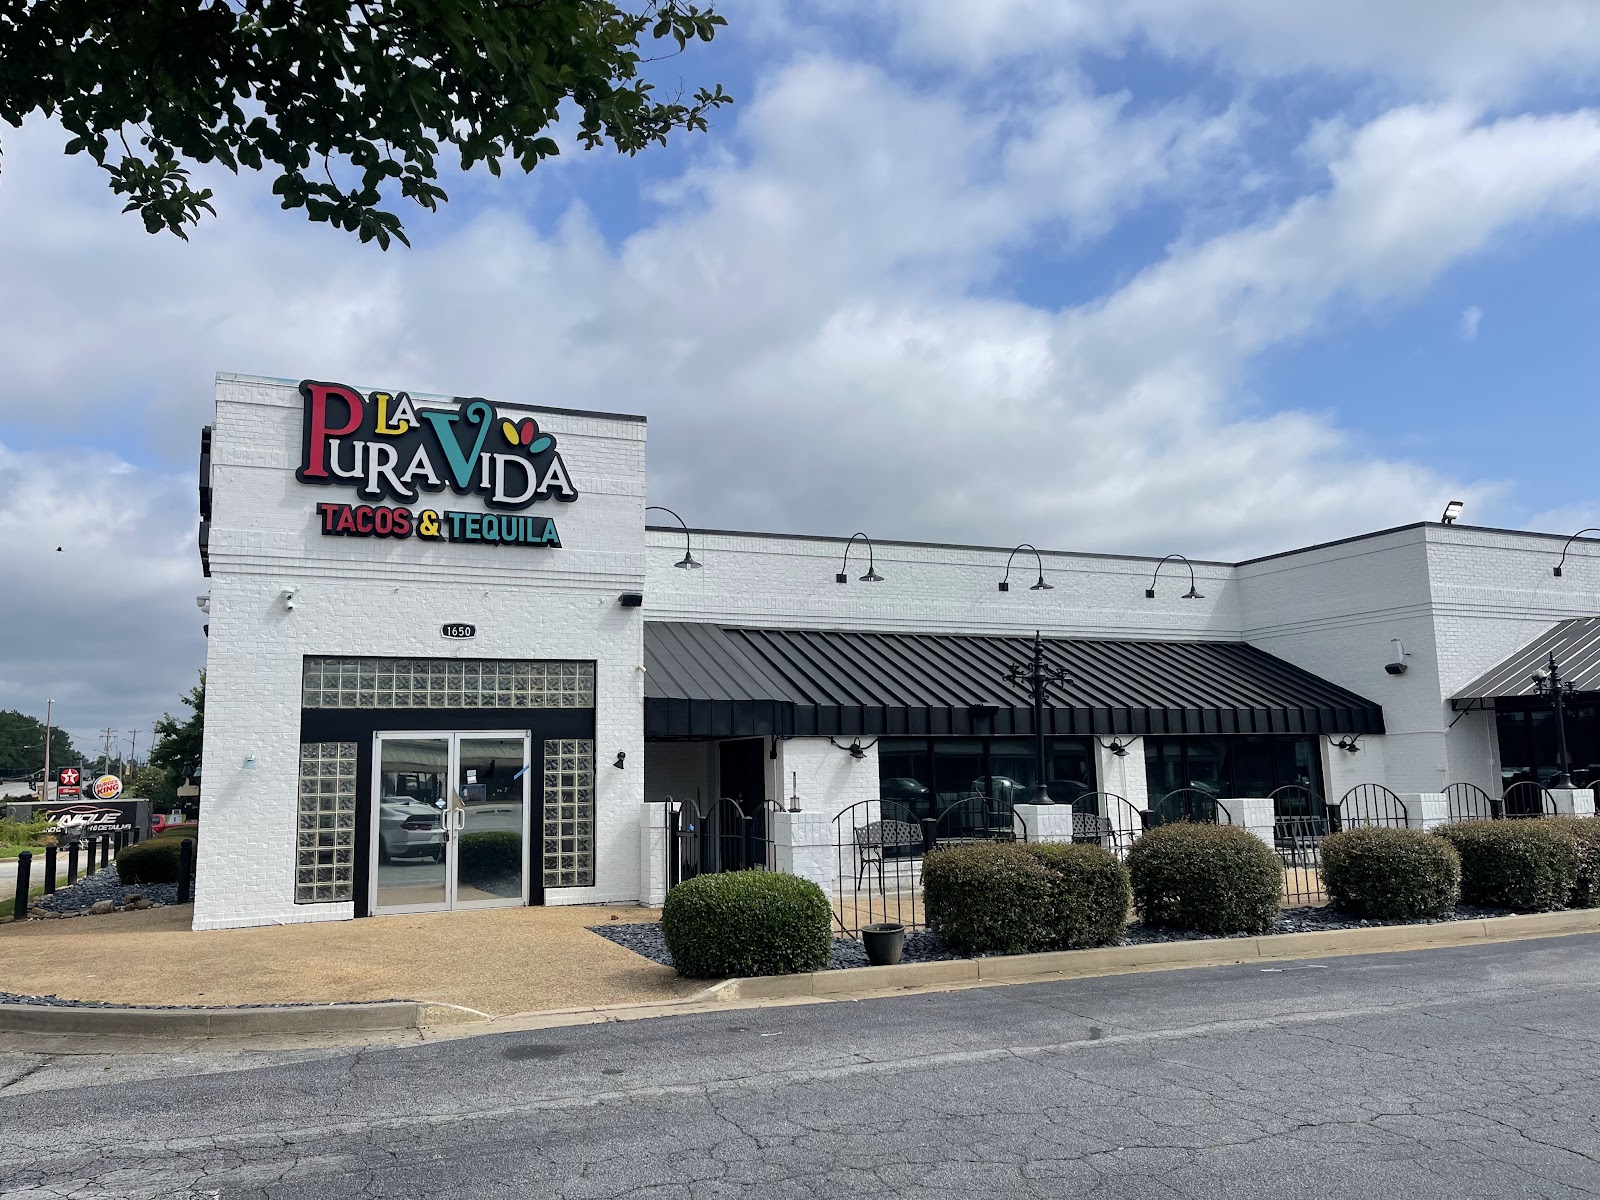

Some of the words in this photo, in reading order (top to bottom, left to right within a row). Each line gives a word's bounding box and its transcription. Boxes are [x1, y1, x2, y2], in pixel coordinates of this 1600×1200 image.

[375, 394, 420, 435] LA
[303, 383, 442, 496] PURA
[422, 401, 574, 503] VIDA
[320, 503, 410, 535] TACOS
[419, 510, 440, 537] &
[449, 513, 560, 543] TEQUILA
[447, 626, 471, 637] 1650
[97, 780, 118, 789] BURGER
[97, 785, 119, 795] KING
